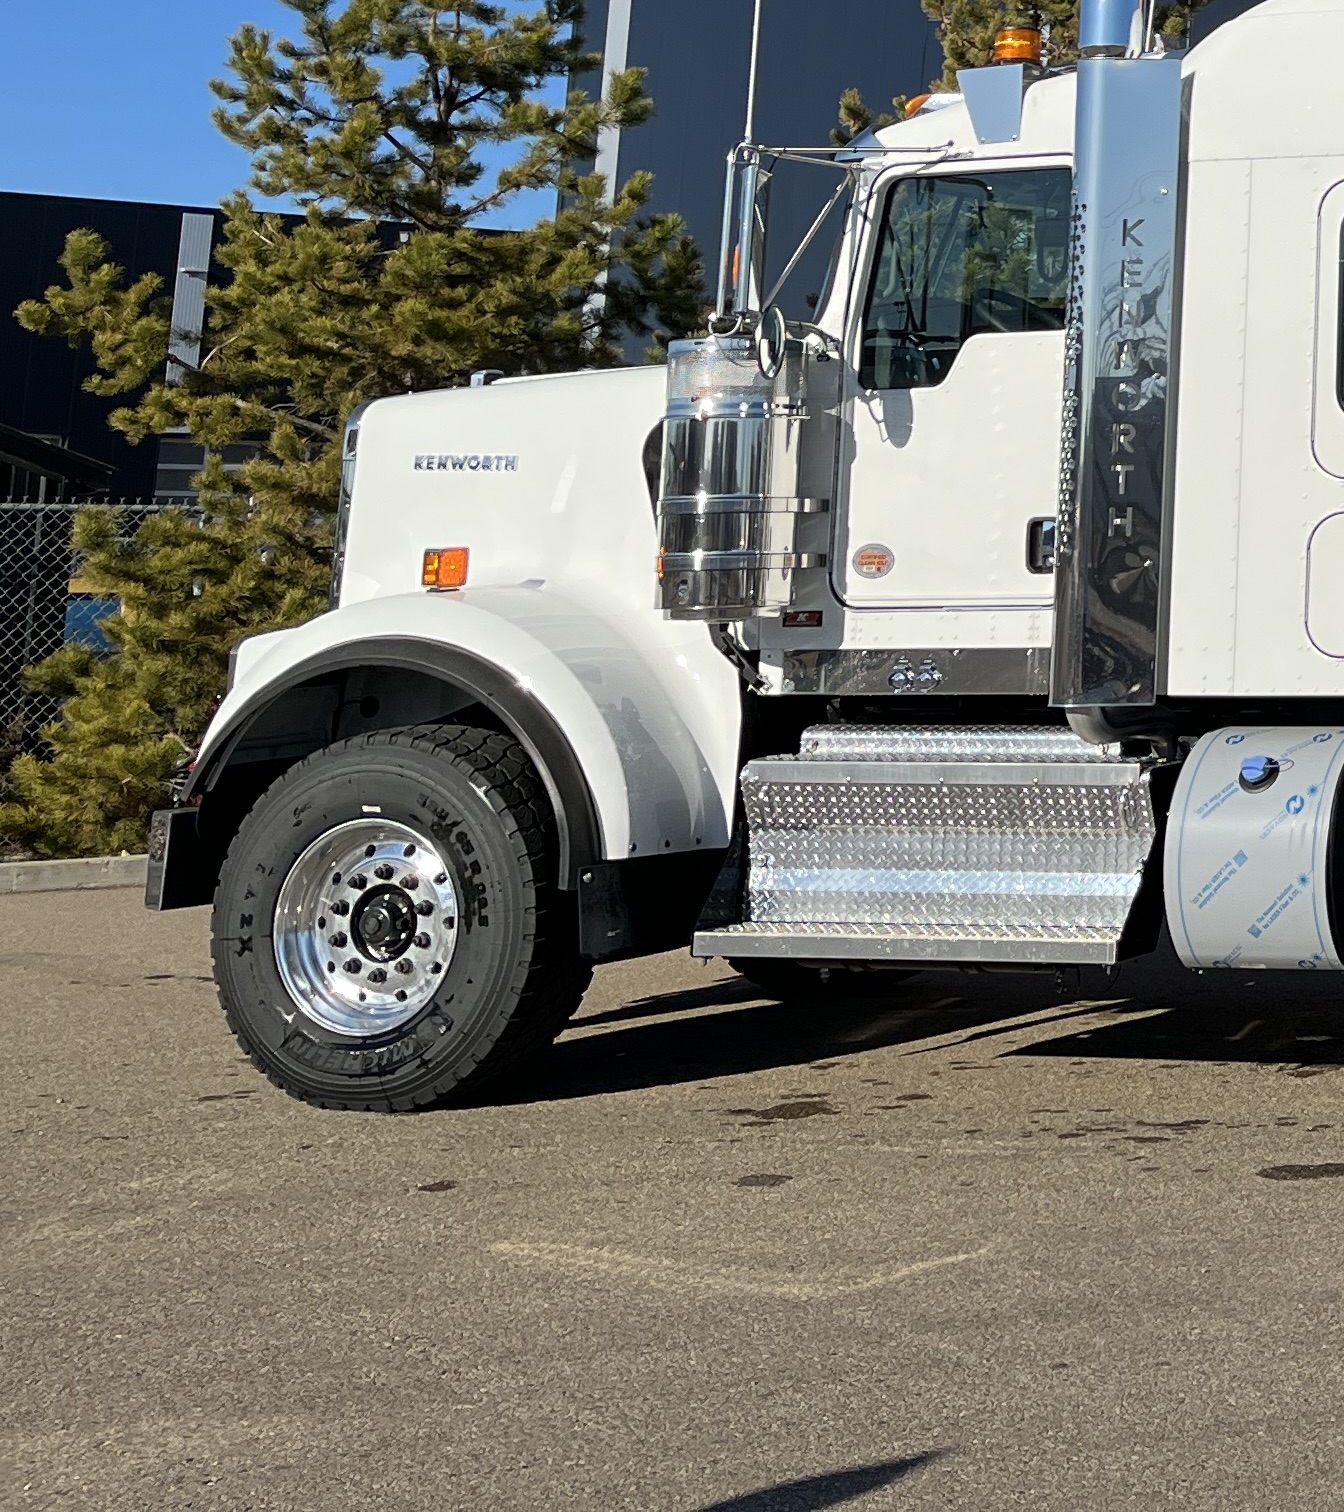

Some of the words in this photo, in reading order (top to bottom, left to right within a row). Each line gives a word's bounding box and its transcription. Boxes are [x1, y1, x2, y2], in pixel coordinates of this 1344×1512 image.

[1107, 218, 1145, 538] KENWORTH
[414, 455, 519, 471] KENWORTH
[287, 1034, 417, 1071] MICHELIN
